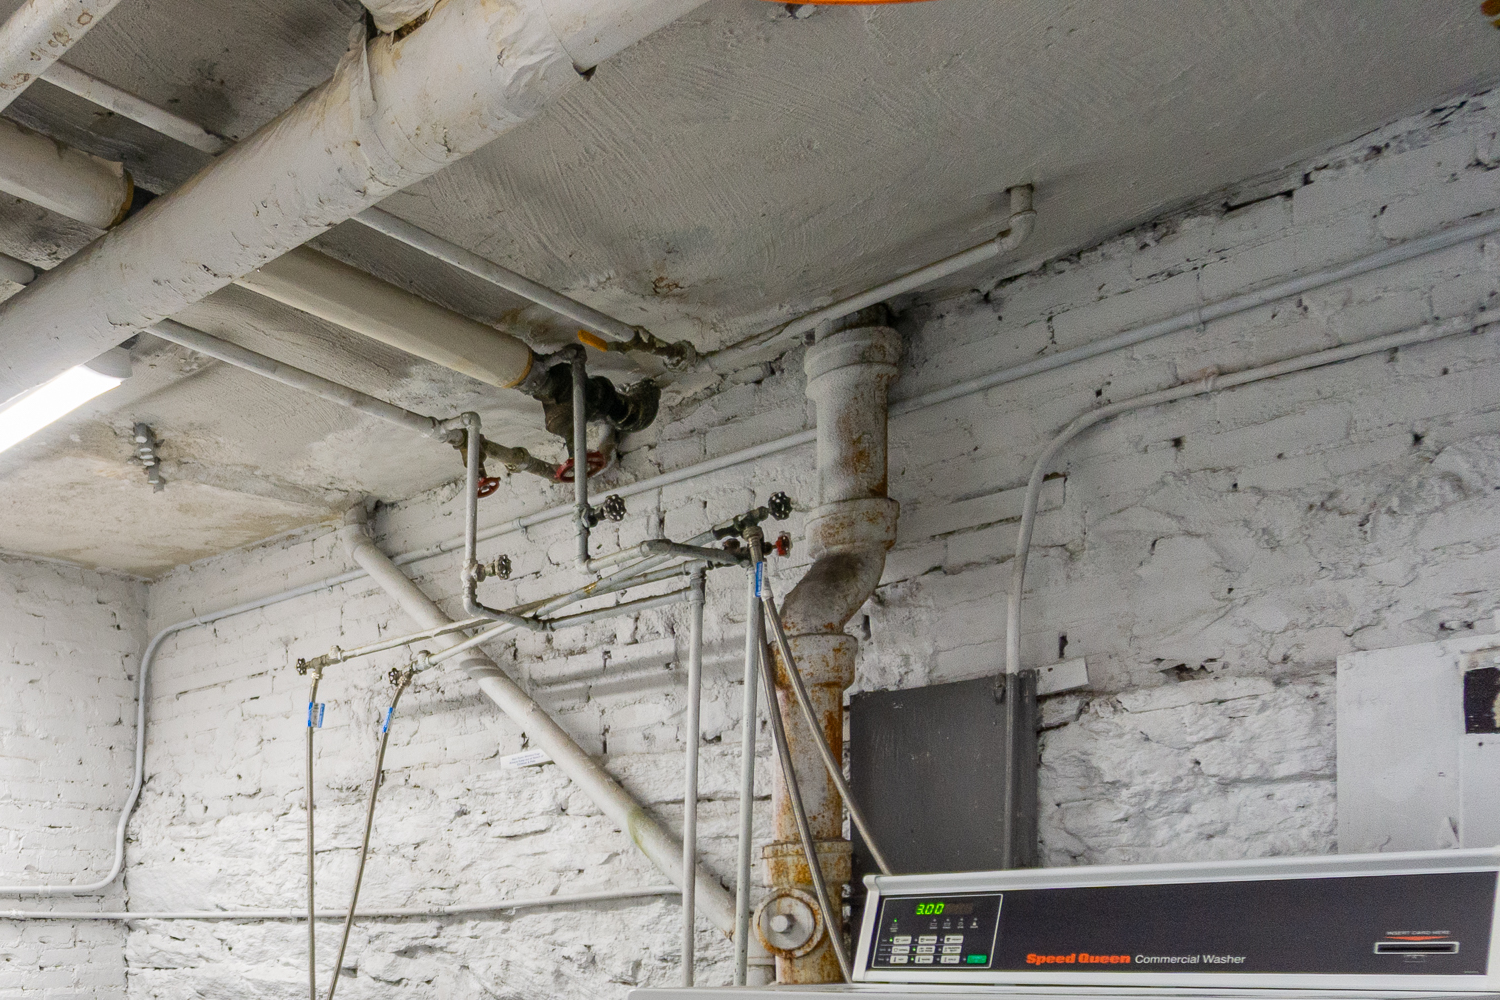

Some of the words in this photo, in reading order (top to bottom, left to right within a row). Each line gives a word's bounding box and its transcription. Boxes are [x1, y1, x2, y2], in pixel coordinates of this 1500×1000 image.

[1026, 954, 1076, 965] Speed
[1078, 954, 1131, 964] Queen
[1135, 954, 1200, 964] Commercial
[1202, 954, 1246, 964] Washer
